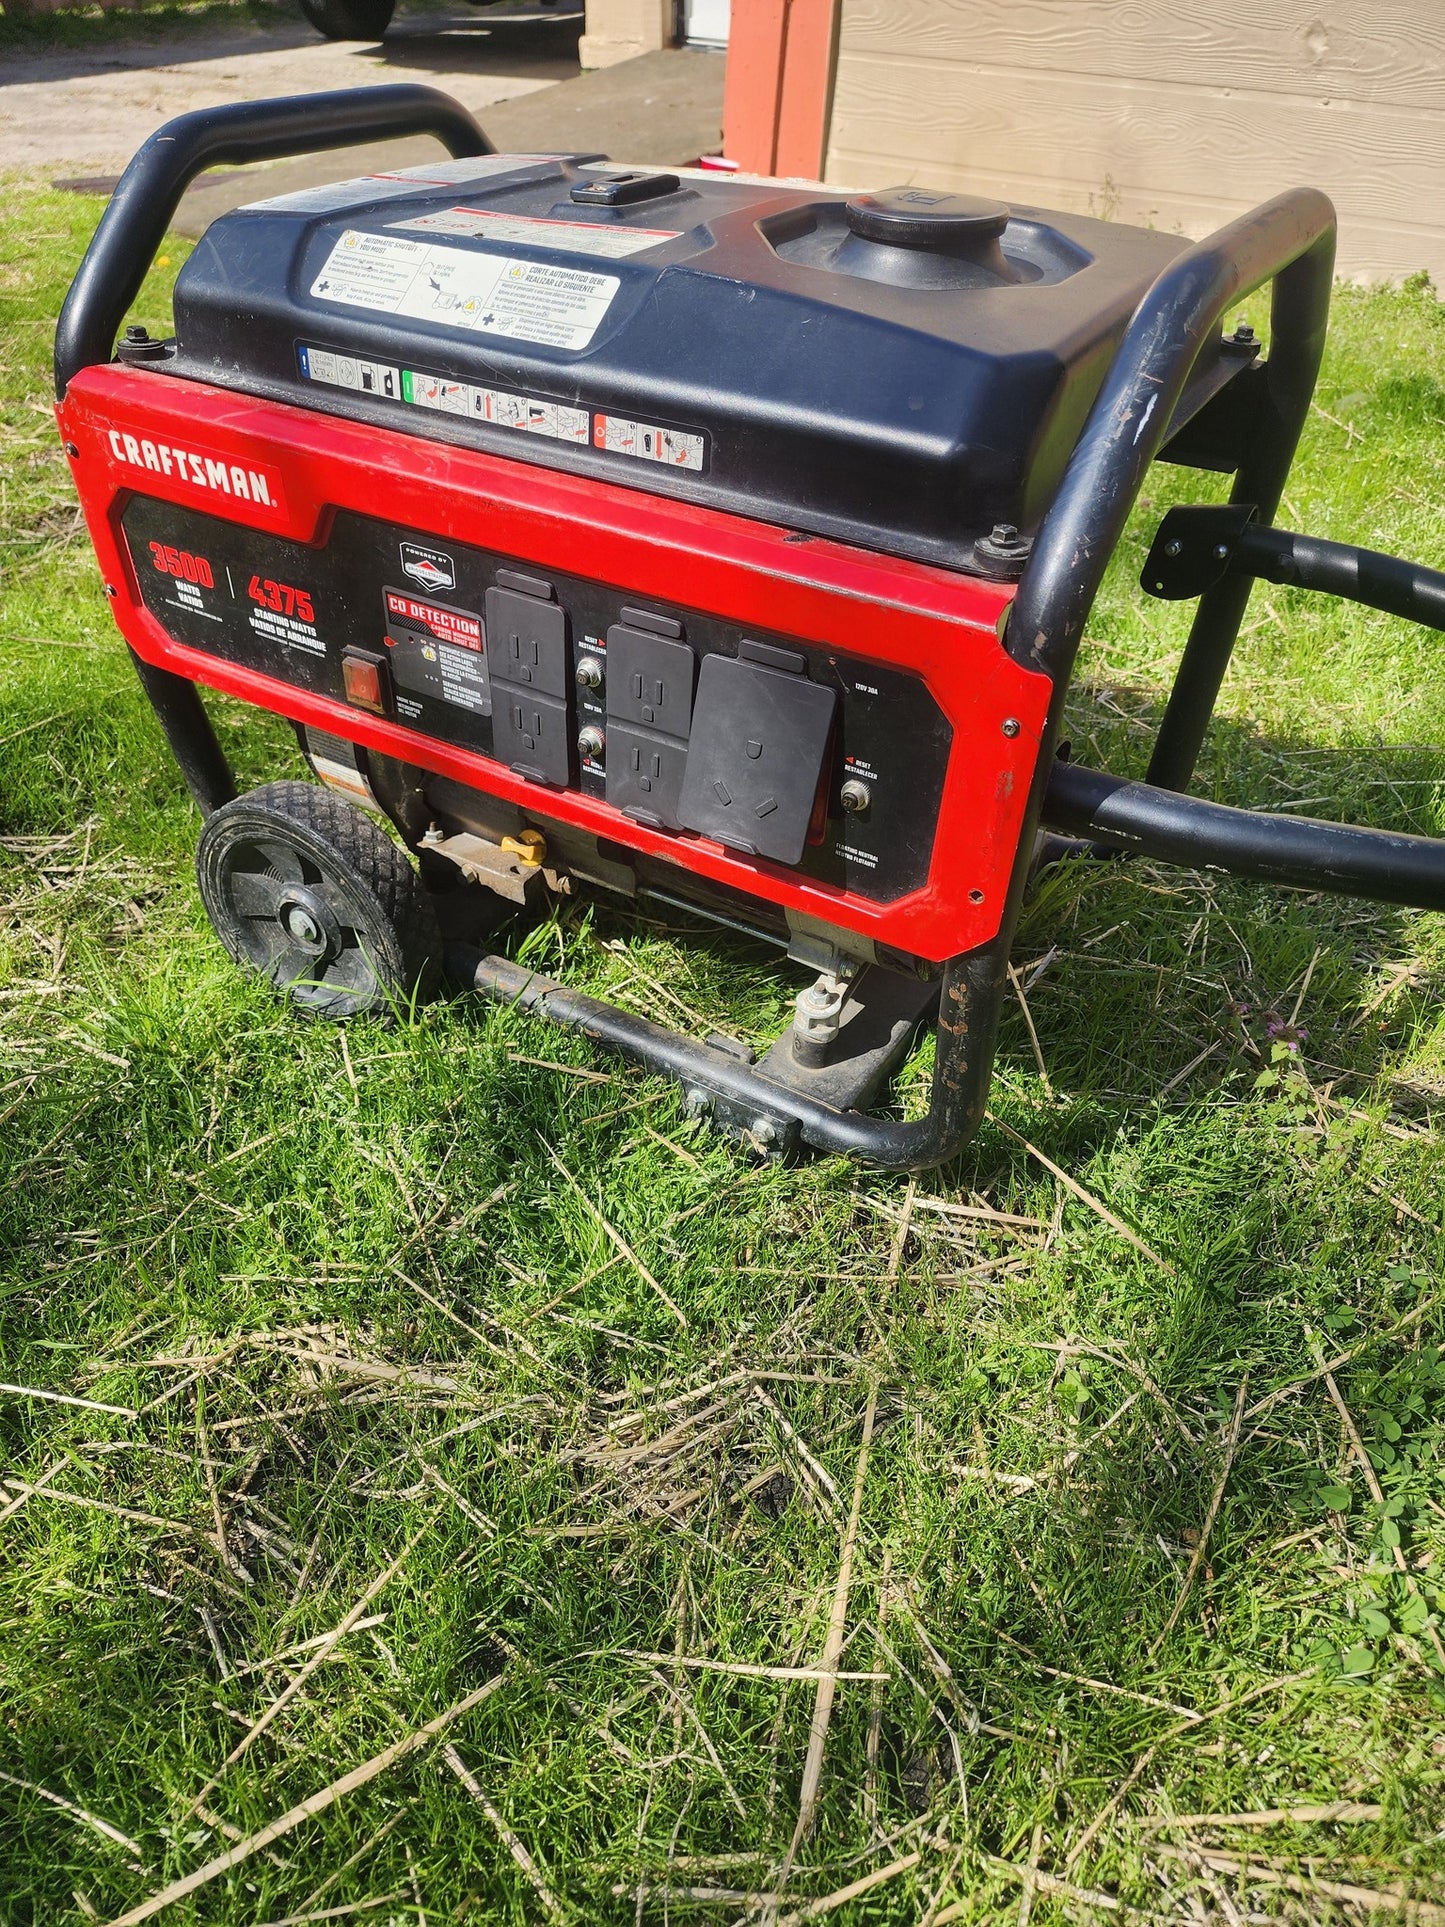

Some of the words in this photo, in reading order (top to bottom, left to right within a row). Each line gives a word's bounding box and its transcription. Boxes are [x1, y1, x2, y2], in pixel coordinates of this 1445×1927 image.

[360, 244, 371, 252] YOU
[371, 246, 387, 254] MUST
[364, 237, 393, 248] AUTOMATIC
[525, 275, 554, 287] REALIZAR
[563, 281, 596, 293] SIGUIENTE
[529, 266, 548, 277] CORTE
[548, 268, 588, 283] AUTOMÁTICO
[588, 277, 606, 287] DEBE
[108, 430, 271, 506] CRAFTSMAN
[405, 547, 437, 561] POWERED
[148, 540, 215, 589] 3500
[175, 580, 201, 597] WATTS
[178, 592, 204, 608] VATIOS
[248, 575, 315, 623] 4375
[253, 607, 290, 628] STARTING
[289, 619, 317, 637] WATTS
[389, 597, 407, 613] CO
[410, 603, 480, 636] DETECTION
[249, 617, 276, 635] VATIOS
[275, 625, 288, 638] DE
[287, 630, 327, 652] ARRANQUE
[430, 623, 453, 635] CARBON
[452, 630, 479, 643] MONOXIDE
[437, 632, 453, 642] AUTO
[438, 644, 461, 657] AUTOMATIC
[439, 651, 448, 659] SEE
[855, 683, 868, 693] 120V
[867, 685, 878, 695] 30A
[844, 764, 878, 780] RESTABLECER
[855, 759, 871, 770] RESET
[835, 850, 854, 862] NEUTRO
[853, 854, 876, 869] FLOTANTE
[836, 842, 858, 857] FLOATING
[857, 849, 879, 863] NEUTRAL
